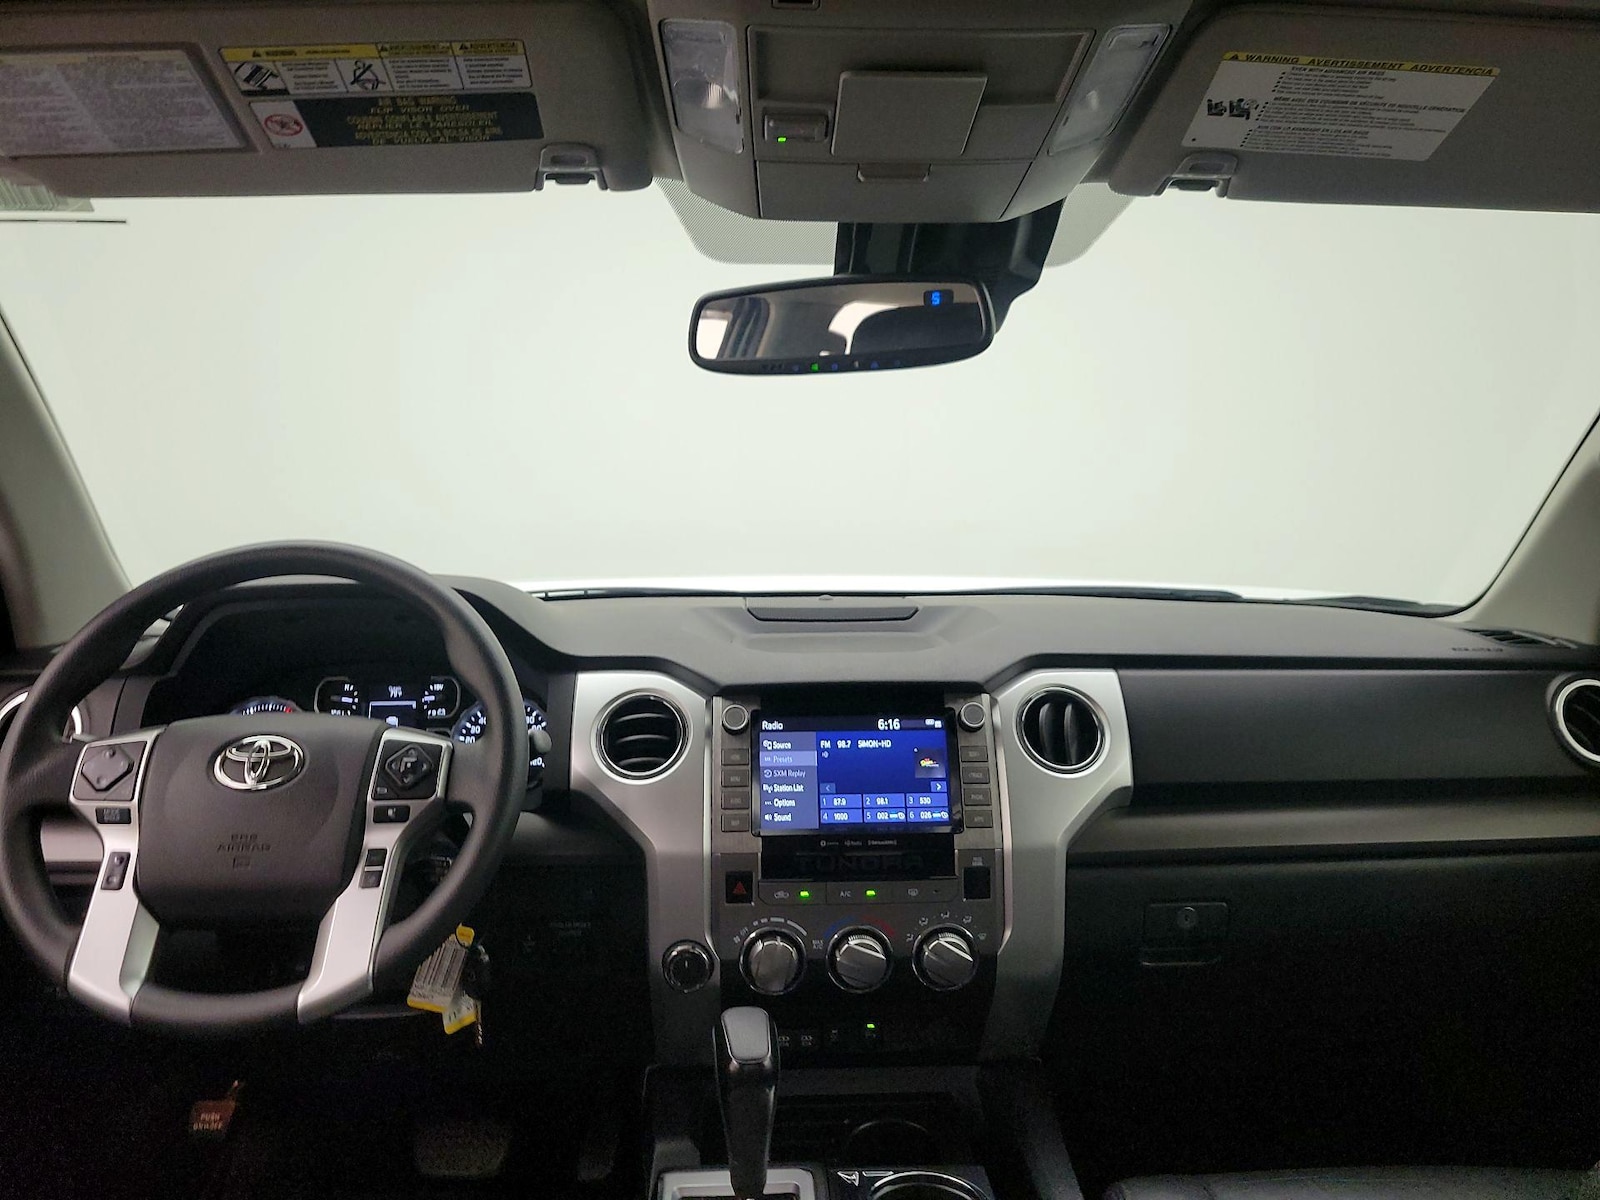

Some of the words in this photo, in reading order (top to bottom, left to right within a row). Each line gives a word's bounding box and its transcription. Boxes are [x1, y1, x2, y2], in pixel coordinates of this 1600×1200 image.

[1246, 54, 1300, 64] WARNING
[1308, 58, 1405, 70] AVERTISSEMENT
[1411, 64, 1492, 76] ADVERTENCIA
[762, 720, 784, 730] Radio
[877, 718, 900, 731] 6:16
[773, 740, 792, 750] Source
[820, 740, 831, 749] FM
[836, 740, 852, 749] 98.7
[773, 755, 793, 764] Presets
[773, 769, 787, 778] SXM
[788, 769, 806, 779] Replay
[773, 783, 792, 792] Station
[793, 783, 804, 792] List
[773, 798, 796, 808] Options
[773, 812, 792, 822] Sound
[216, 844, 271, 852] AIRBAG
[840, 890, 852, 898] A/C
